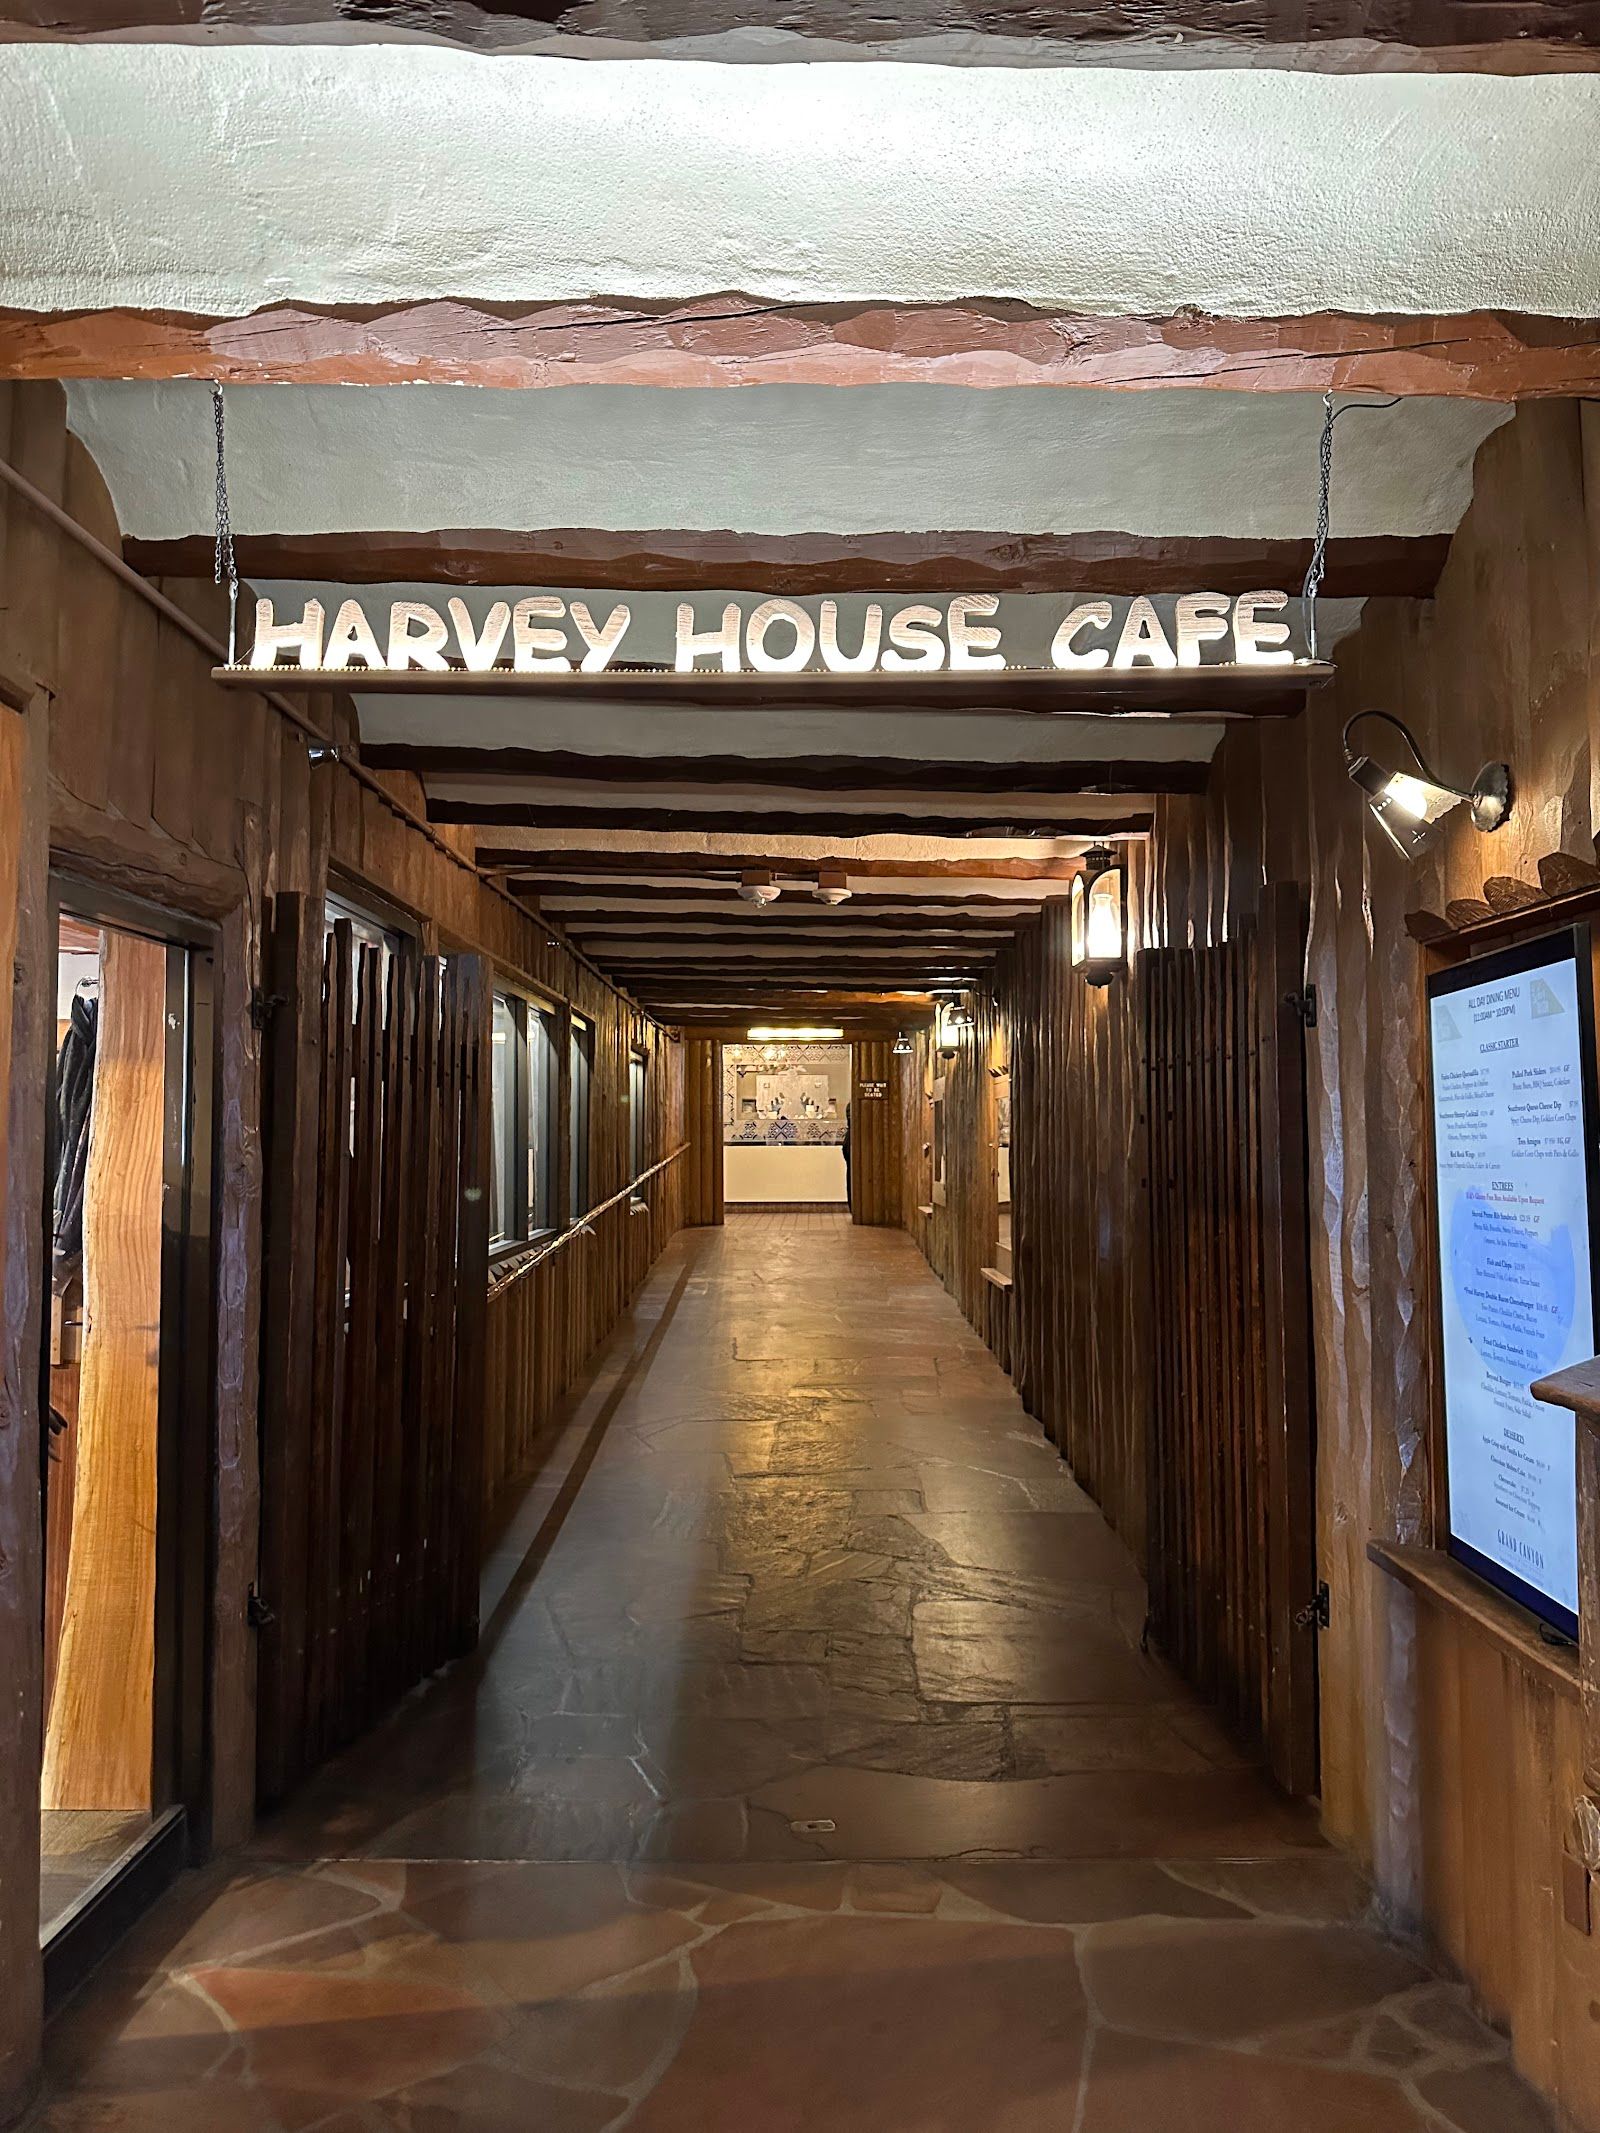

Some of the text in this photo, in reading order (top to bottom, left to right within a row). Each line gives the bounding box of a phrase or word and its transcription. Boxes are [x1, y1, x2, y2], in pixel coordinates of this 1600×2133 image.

[250, 590, 1296, 673] HARVEY HOUSE CAFE
[1468, 986, 1521, 1009] ALL DAY DINING MENU
[1480, 1038, 1520, 1054] CLASSIC STARTER
[1492, 1182, 1514, 1191] ENTREES
[1498, 1528, 1545, 1570] GRAND CANYON
